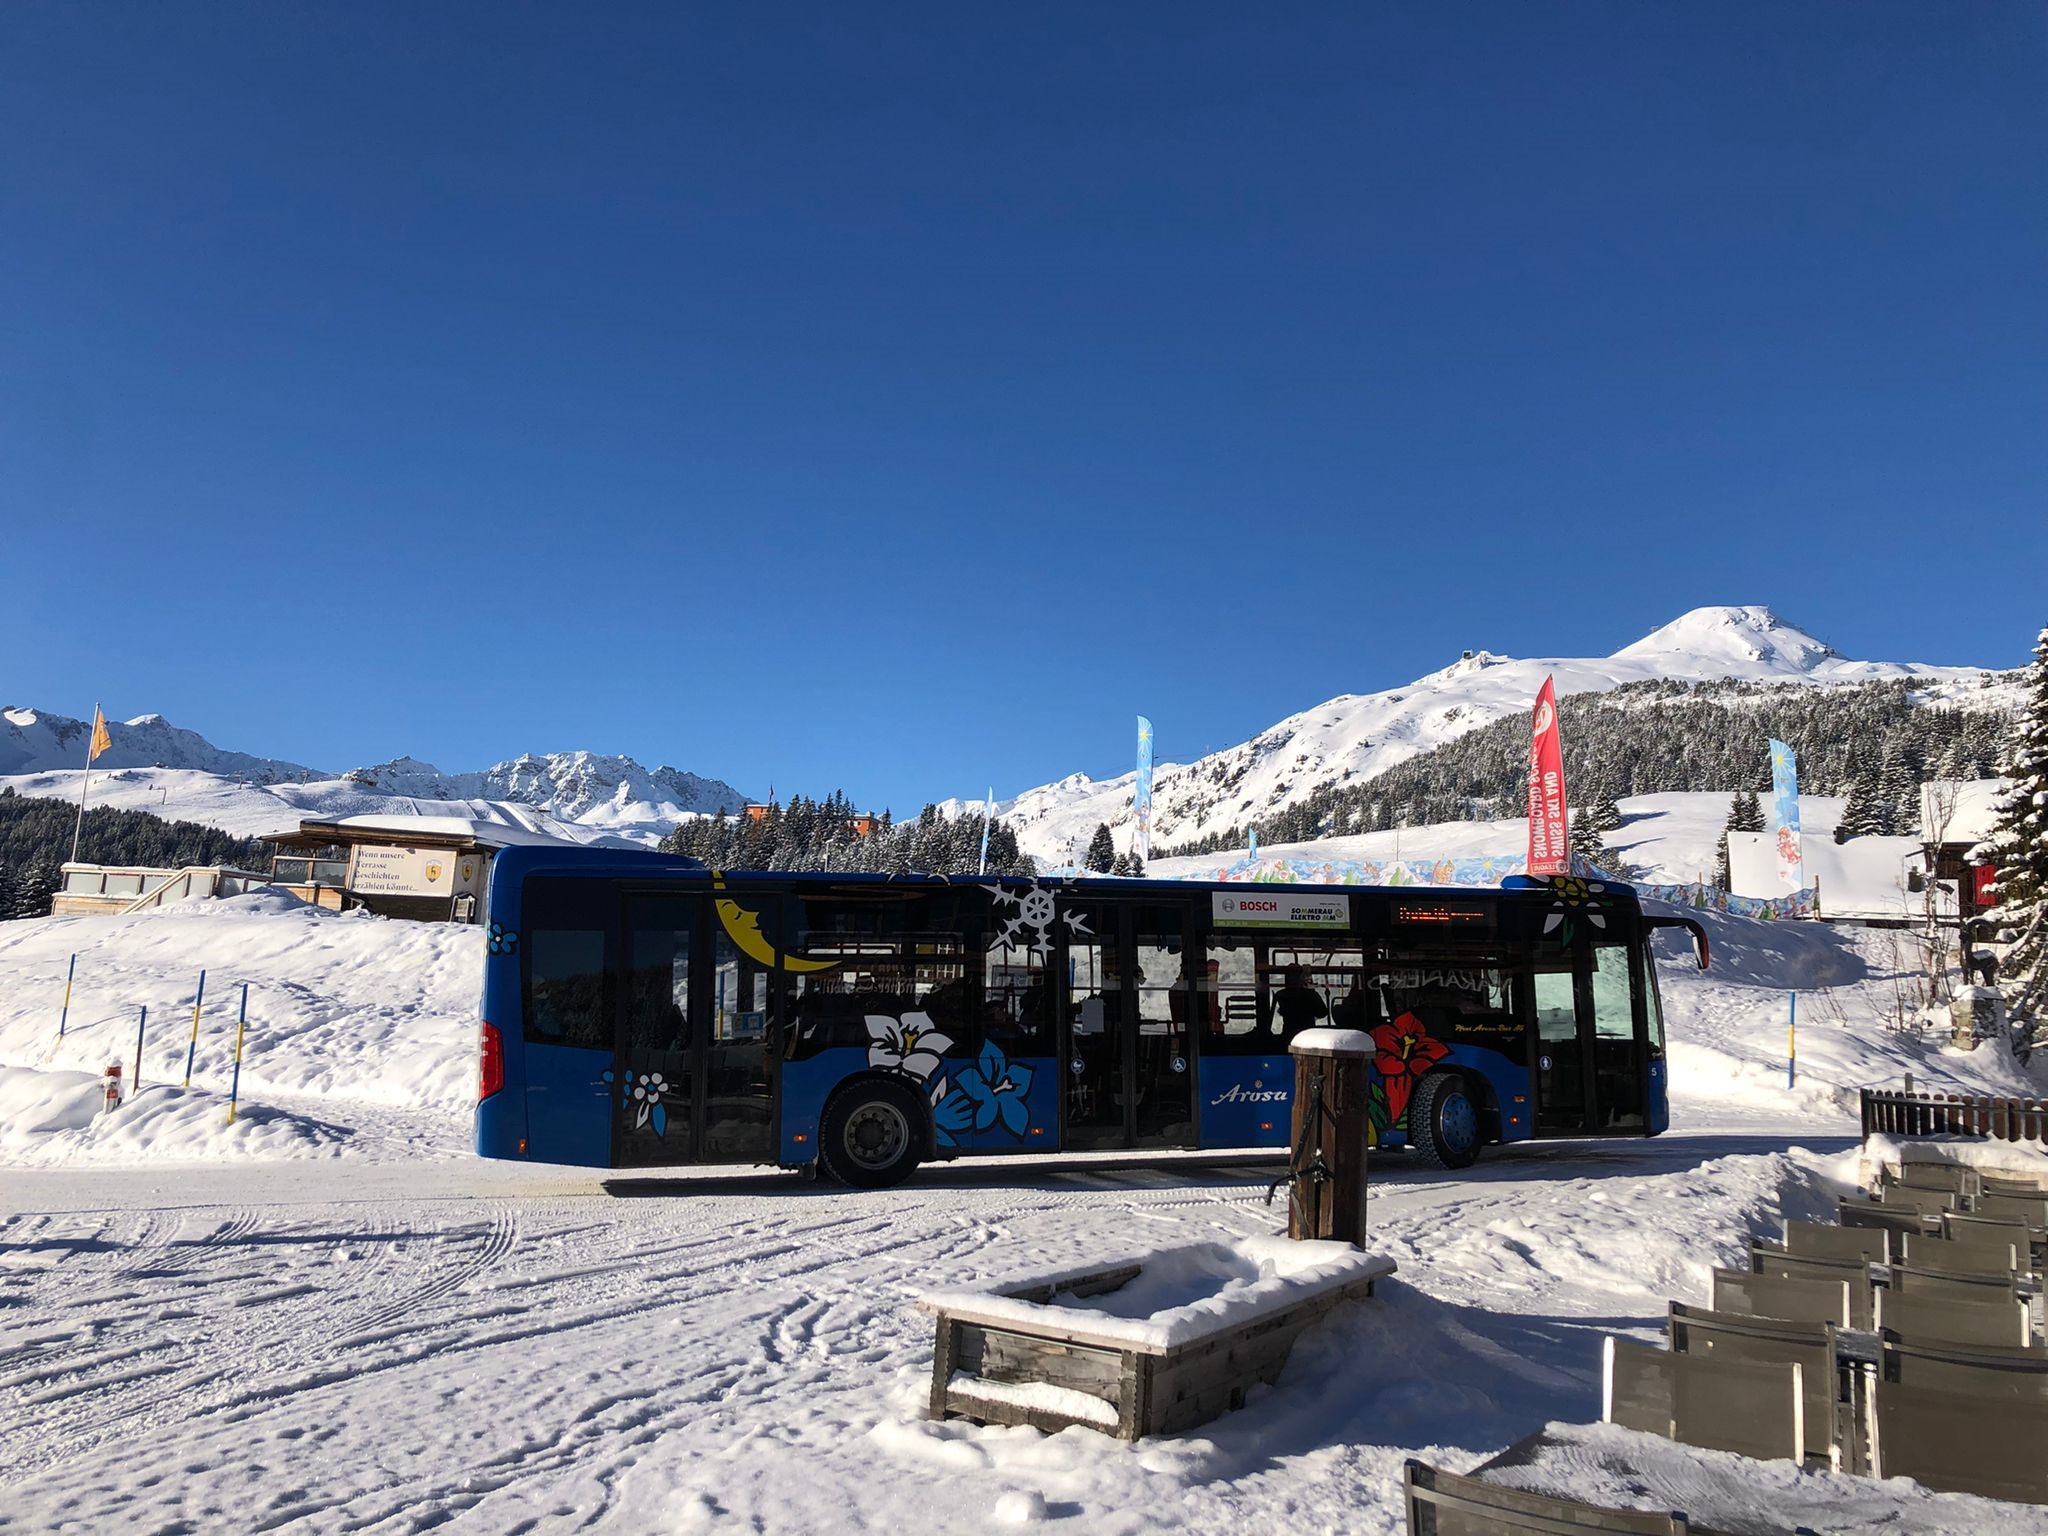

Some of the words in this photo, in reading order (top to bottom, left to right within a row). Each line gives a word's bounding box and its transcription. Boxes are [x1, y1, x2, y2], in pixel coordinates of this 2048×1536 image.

[1240, 901, 1277, 911] BOSCH
[1651, 1067, 1657, 1076] 5
[1211, 1084, 1288, 1105] Arosa
